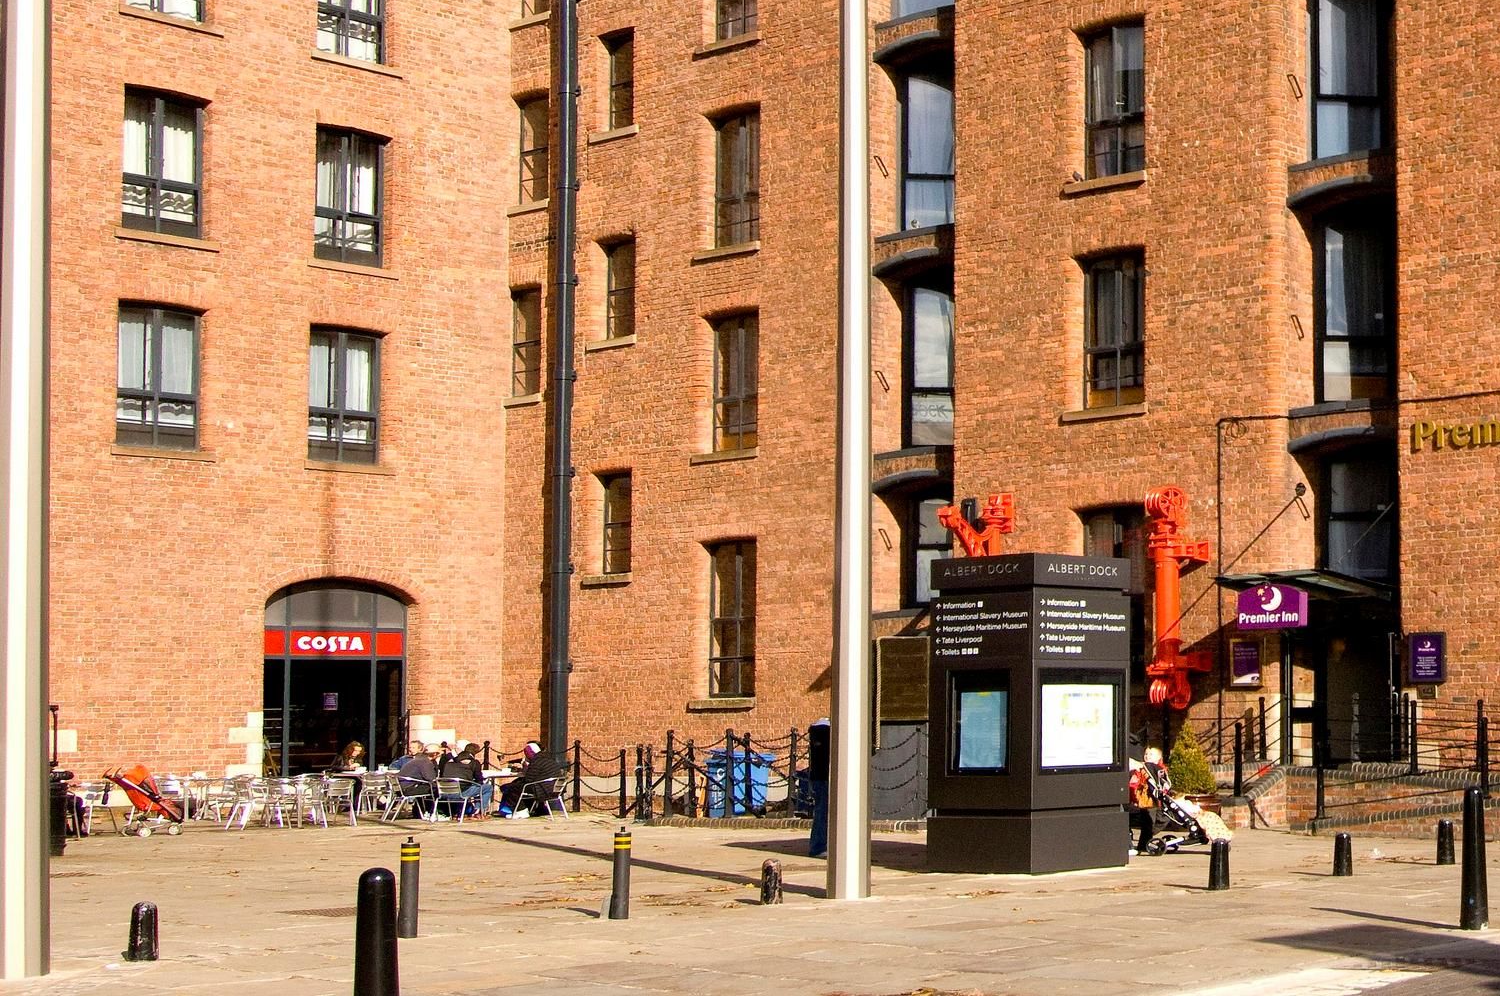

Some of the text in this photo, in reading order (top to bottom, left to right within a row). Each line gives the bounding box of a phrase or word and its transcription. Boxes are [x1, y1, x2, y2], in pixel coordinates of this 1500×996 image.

[944, 563, 1020, 577] ALBERT DOCK
[1047, 563, 1118, 576] ALBERT DOCK
[1047, 598, 1080, 607] Information
[942, 613, 979, 621] International
[980, 612, 1001, 620] Slavery
[1047, 610, 1126, 620] International Slavery Museum
[1239, 610, 1298, 624] Premier Inn
[942, 622, 1027, 633] Merseyside Maritime Museum
[1046, 622, 1126, 632] Merseyside Maritime Museum
[955, 636, 982, 644] Liverpool
[1059, 634, 1085, 642] Liverpool
[297, 636, 364, 652] COSTA
